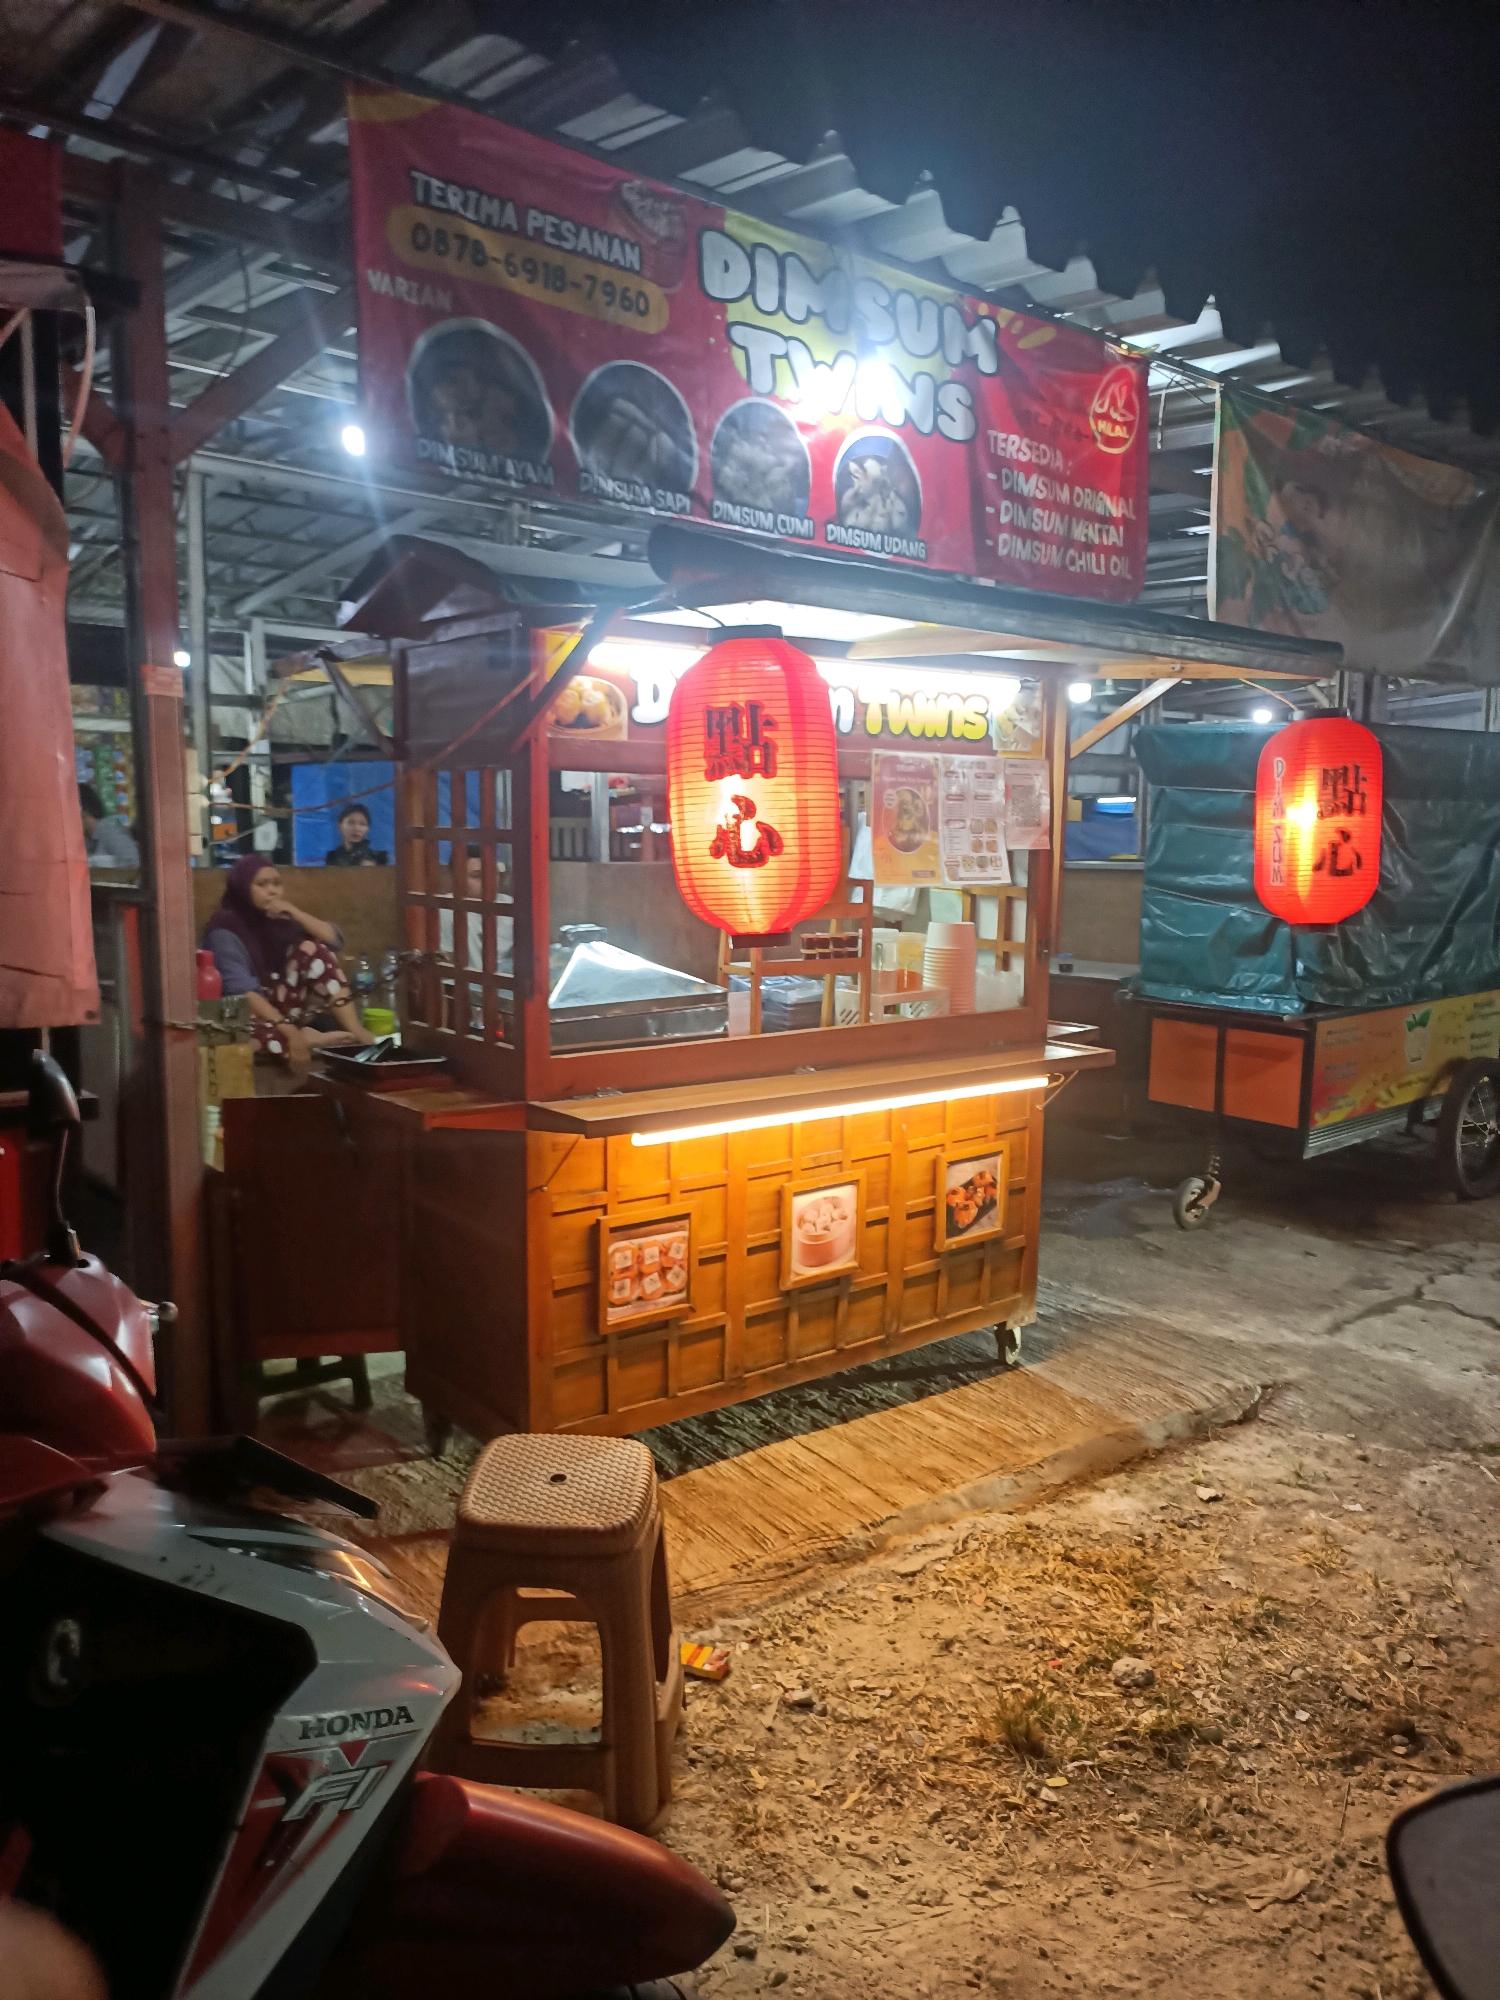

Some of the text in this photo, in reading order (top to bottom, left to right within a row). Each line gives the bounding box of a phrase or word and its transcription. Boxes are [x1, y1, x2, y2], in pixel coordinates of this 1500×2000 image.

[410, 171, 641, 271] TERIMA PESANAN
[411, 223, 650, 317] 0878-6918-7960
[699, 229, 1000, 374] DIMSUM
[727, 322, 978, 442] TWINS
[579, 471, 691, 515] DIMSUM SAPI
[1000, 500, 1068, 536] DIMSUM
[1001, 467, 1070, 505] DIMSUM
[1073, 487, 1137, 521] ORIGINAL
[711, 502, 814, 539] DIMSUM CUMI
[826, 525, 927, 560] DIMSUM UDANG
[997, 532, 1062, 570] DIMSUM
[1064, 548, 1106, 576] CHILI
[1109, 555, 1134, 580] OIL
[705, 700, 784, 868] 點心
[1312, 764, 1368, 877] 點心
[298, 1705, 414, 1741] HONDA
